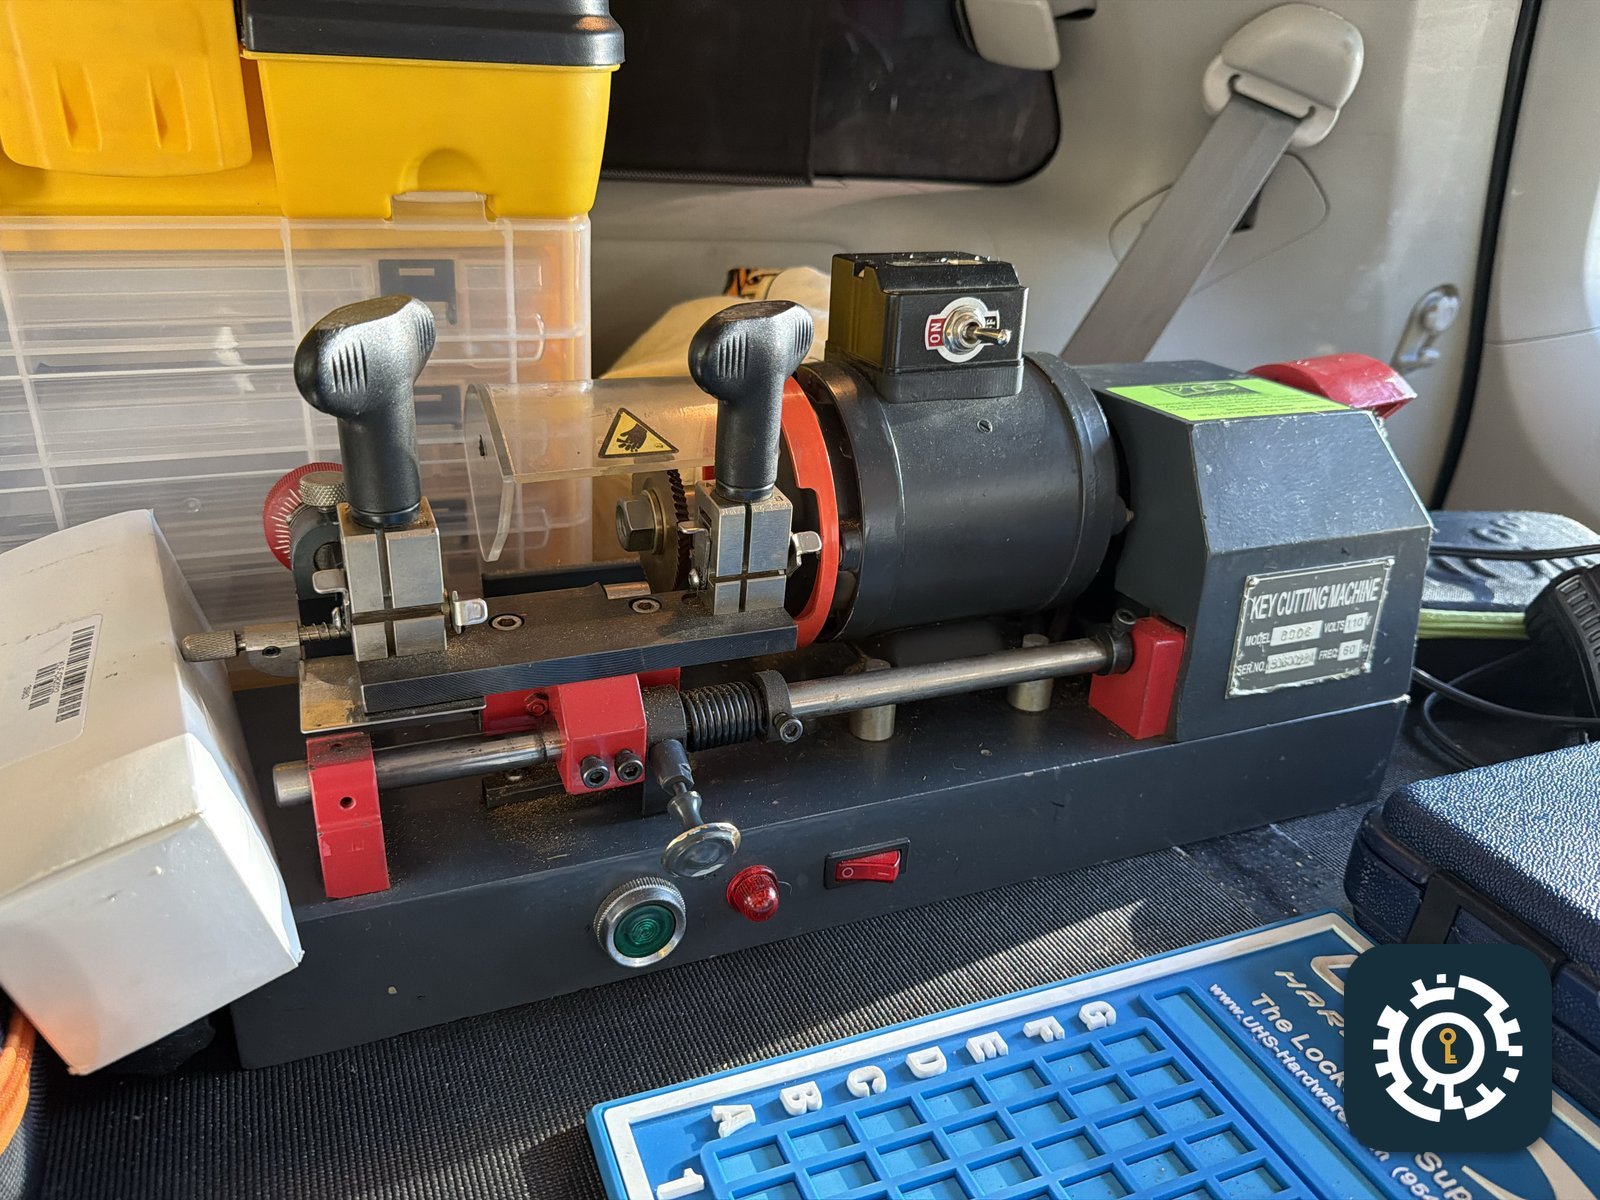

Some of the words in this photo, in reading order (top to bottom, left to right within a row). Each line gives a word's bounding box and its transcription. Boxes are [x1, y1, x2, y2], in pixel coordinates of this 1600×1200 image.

[929, 322, 942, 343] ON
[1250, 592, 1279, 620] KEY
[1276, 585, 1329, 616] CUTTING
[1327, 577, 1382, 608] MACHINE
[1245, 632, 1271, 647] MODEL
[1324, 620, 1345, 633] VOLTS
[1345, 617, 1363, 630] 110
[1342, 644, 1356, 656] 60
[1251, 992, 1293, 1032] The
[1274, 970, 1344, 1037] HAR
[711, 1104, 756, 1138] A
[779, 1080, 823, 1116] B
[846, 1065, 888, 1098] C
[905, 1045, 948, 1079] D
[965, 1030, 1009, 1064] E
[1022, 1015, 1066, 1043] F
[1078, 1000, 1117, 1032] G
